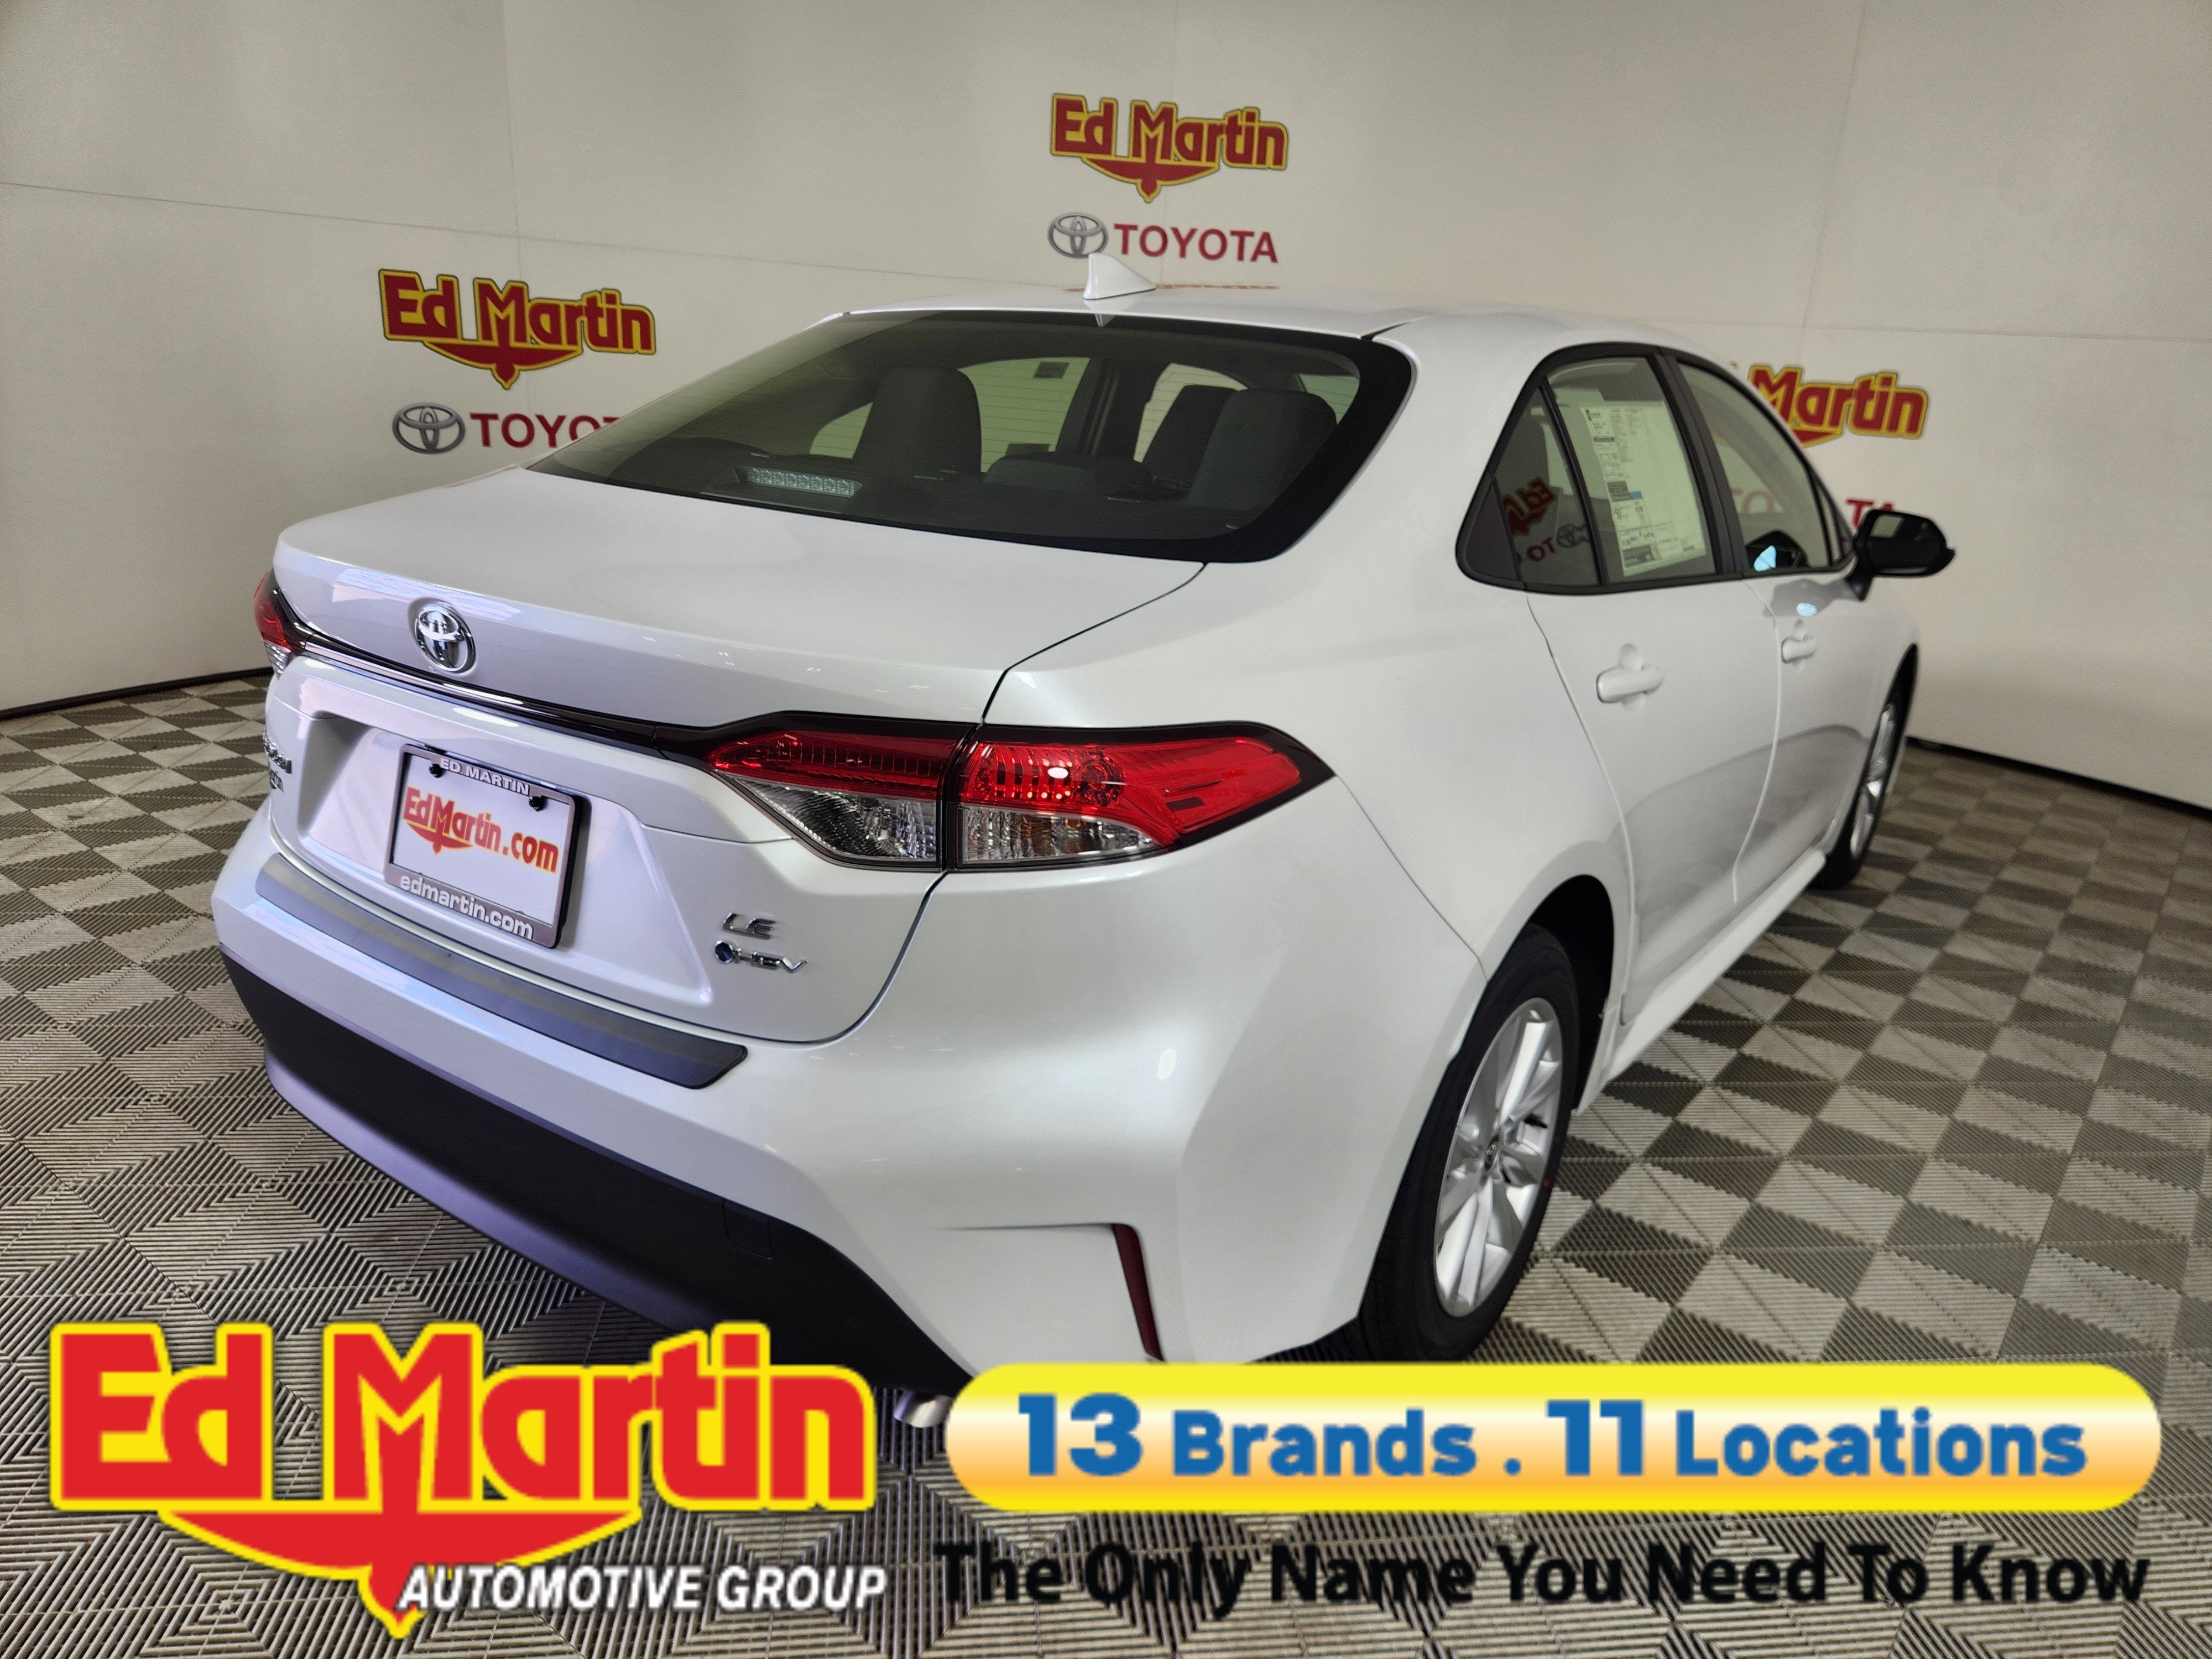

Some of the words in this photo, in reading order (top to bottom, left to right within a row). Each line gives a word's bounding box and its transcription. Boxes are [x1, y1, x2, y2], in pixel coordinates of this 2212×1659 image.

[1051, 93, 1117, 158] Ed
[1129, 100, 1287, 170] Martin
[1114, 223, 1278, 263] TOYOTA
[379, 269, 461, 341] Ed
[473, 278, 655, 354] Martin
[1747, 365, 1928, 439] Martin
[469, 413, 621, 448] TOYO
[440, 758, 462, 773] ED
[466, 766, 530, 796] MARTIN
[400, 875, 534, 940] edmartin.com
[722, 912, 779, 940] LE
